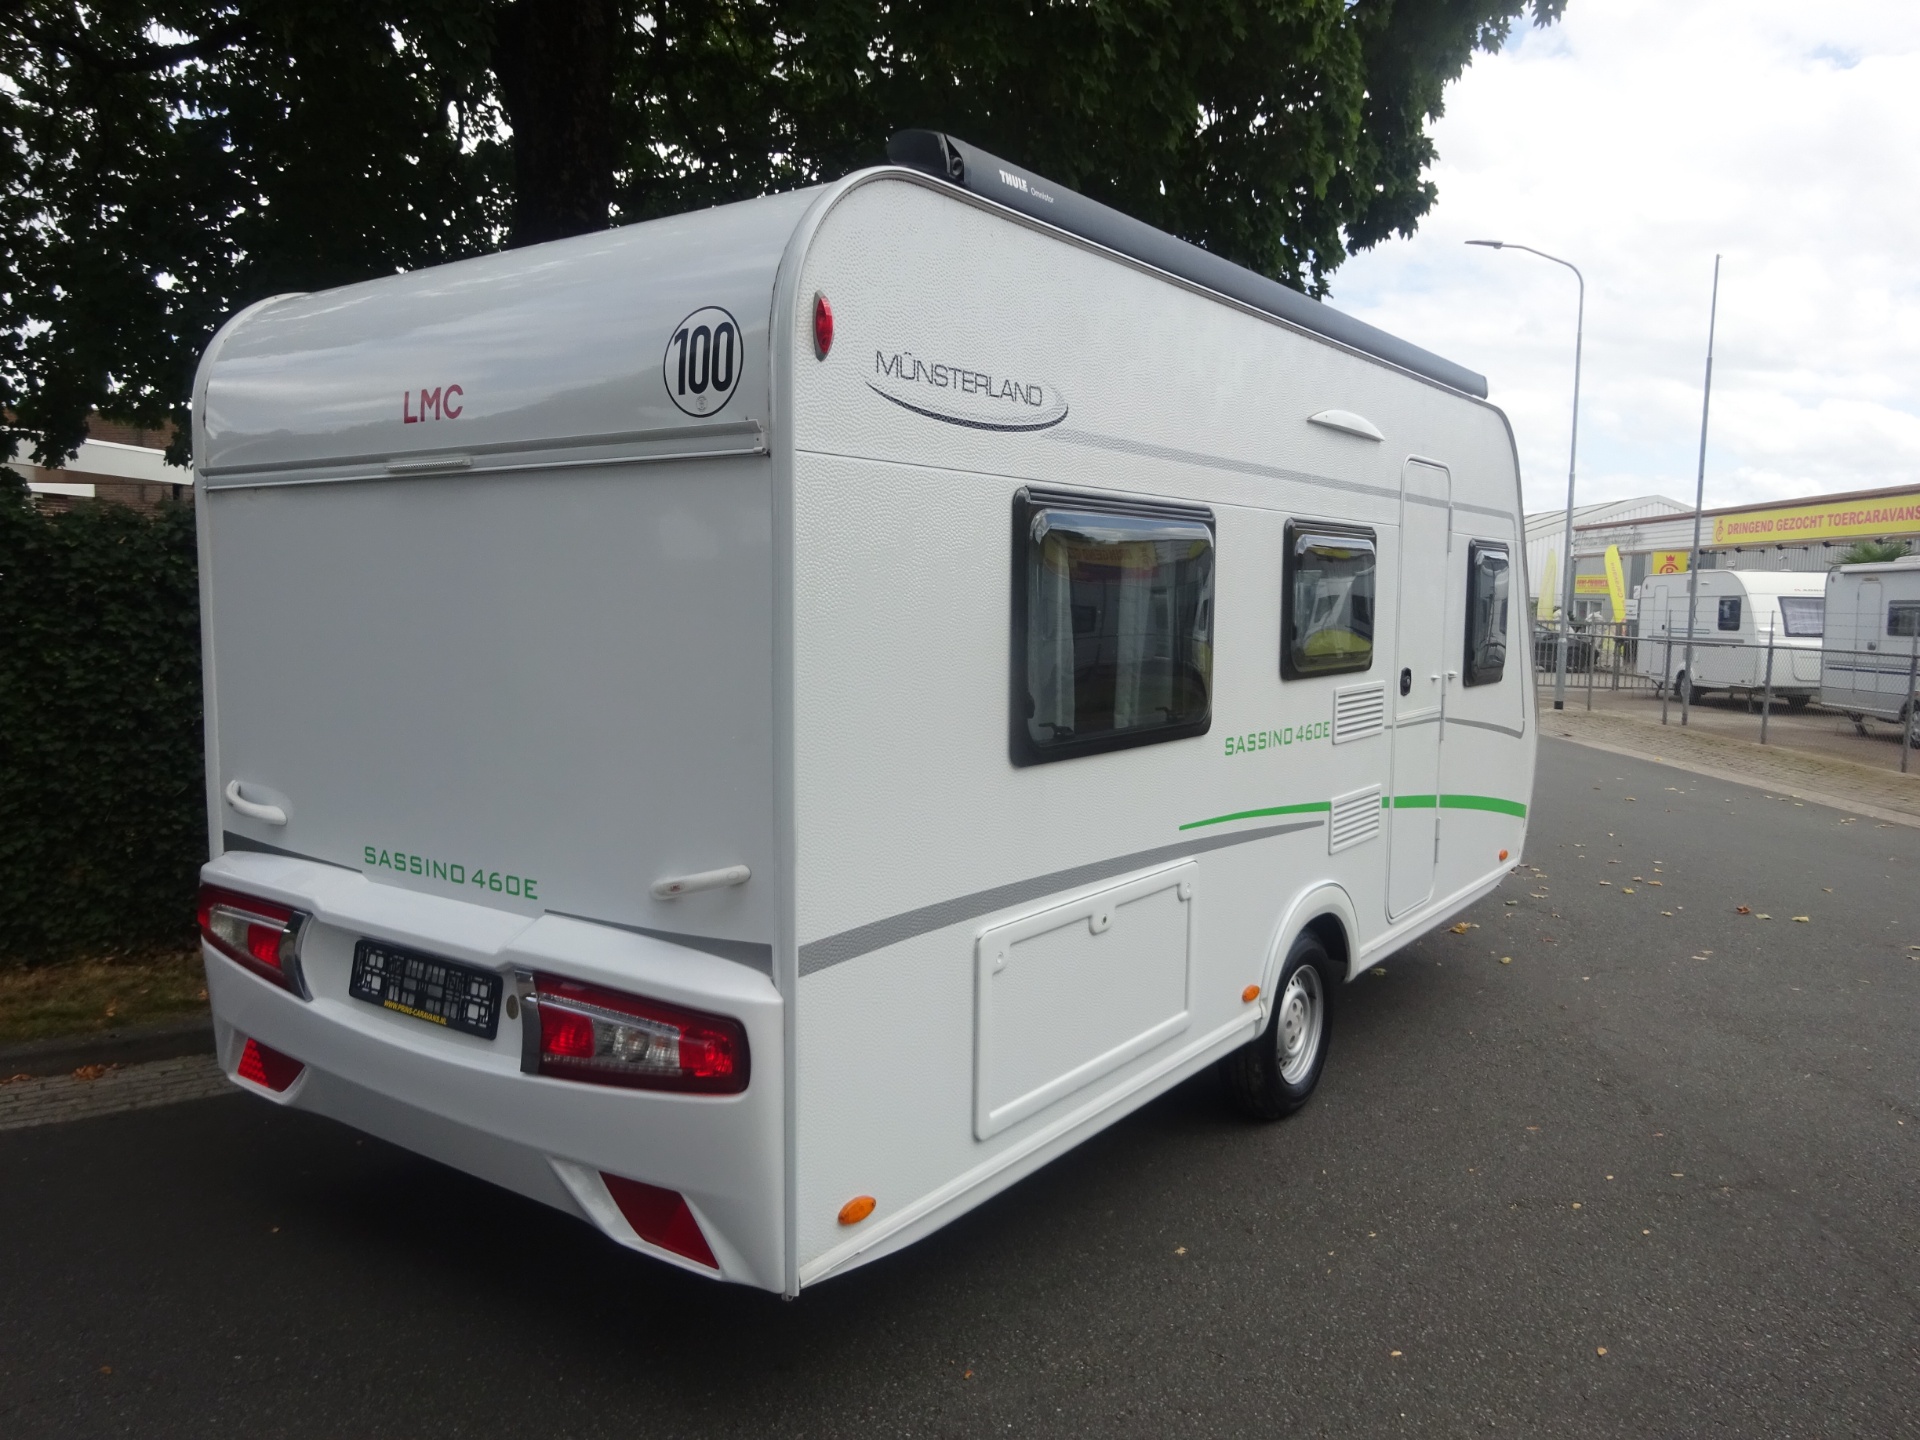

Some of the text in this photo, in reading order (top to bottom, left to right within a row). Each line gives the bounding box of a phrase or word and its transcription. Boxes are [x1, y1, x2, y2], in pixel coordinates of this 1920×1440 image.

[999, 169, 1028, 193] THULE
[674, 321, 735, 396] 100
[875, 350, 1043, 407] MÜNSTERLAND
[403, 384, 464, 424] LMC
[1727, 519, 1774, 536] DRINGEND
[1776, 514, 1824, 532] GEZOCHT
[1827, 505, 1920, 528] TOERCARAVANS
[1224, 721, 1330, 756] SASSINO 460E
[364, 846, 538, 900] SASSINO 460E
[384, 999, 448, 1026] WWW.PRINS-CARAVANS.NL
